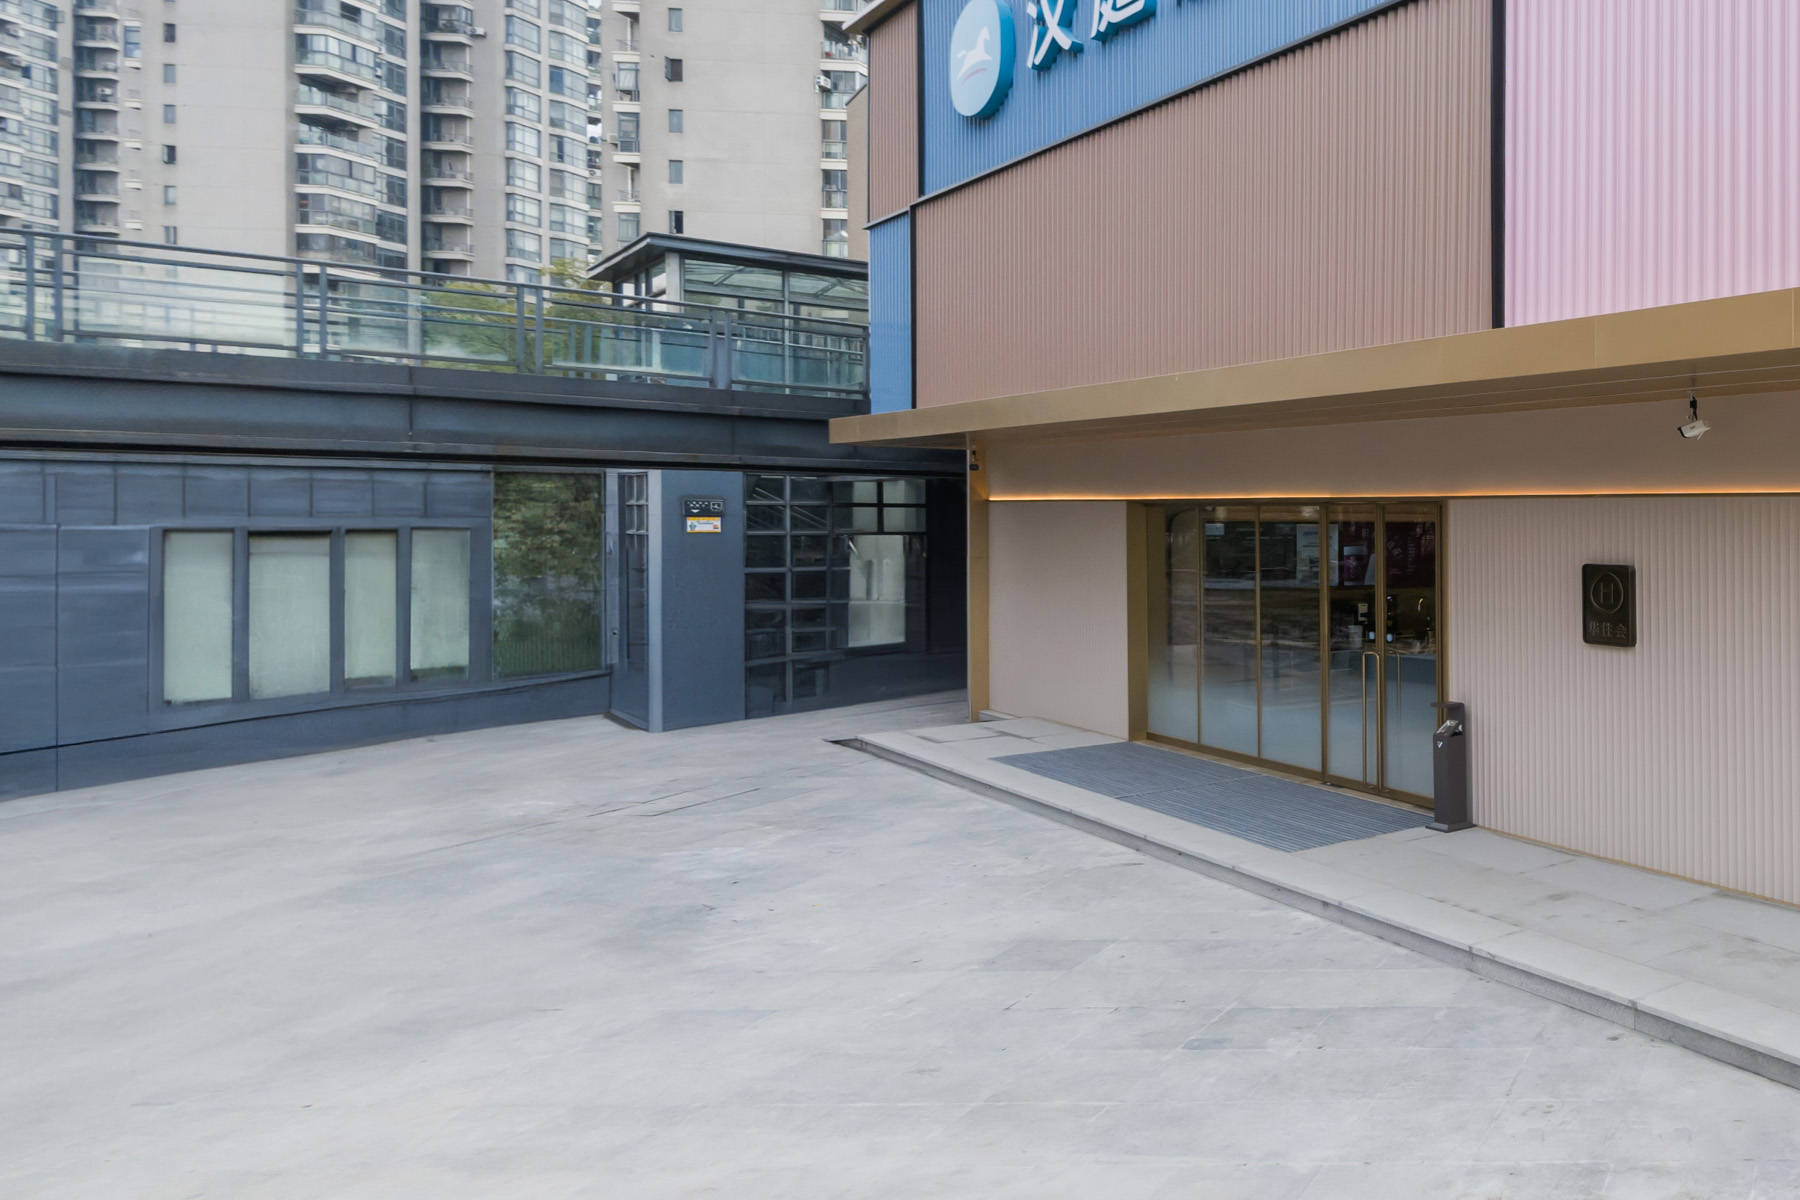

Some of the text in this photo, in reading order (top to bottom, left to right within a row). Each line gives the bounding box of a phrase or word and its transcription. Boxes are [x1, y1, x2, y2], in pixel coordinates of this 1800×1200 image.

[1600, 582, 1614, 605] H
[1589, 621, 1627, 638] 华住会
